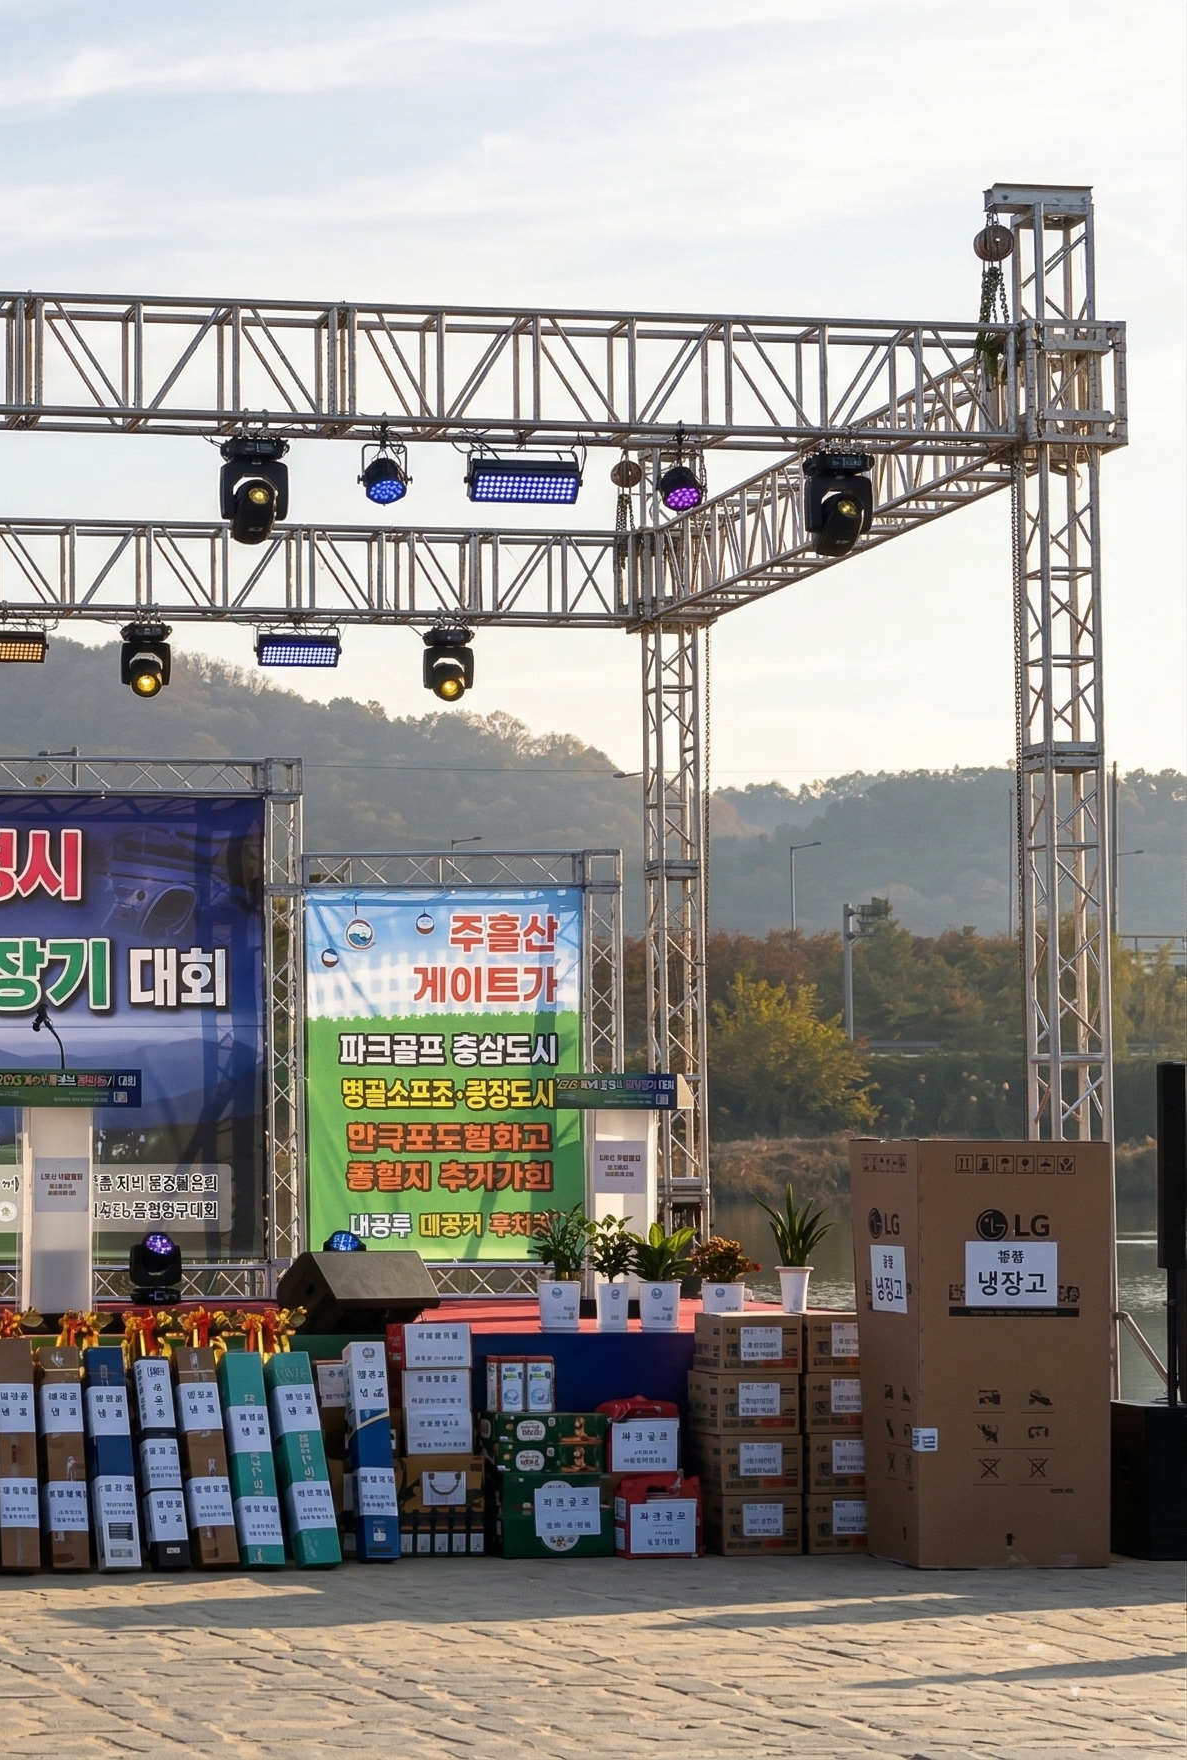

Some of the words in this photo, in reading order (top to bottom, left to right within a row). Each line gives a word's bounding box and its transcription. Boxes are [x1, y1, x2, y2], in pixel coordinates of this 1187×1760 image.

[449, 914, 559, 953] 주흘산
[129, 947, 226, 1006] 대회
[413, 965, 559, 1004] 게이트가
[339, 1034, 445, 1065] 파크골프
[884, 1213, 900, 1235] LG
[1014, 1214, 1050, 1237] LG
[978, 1271, 1048, 1296] 냉장고
